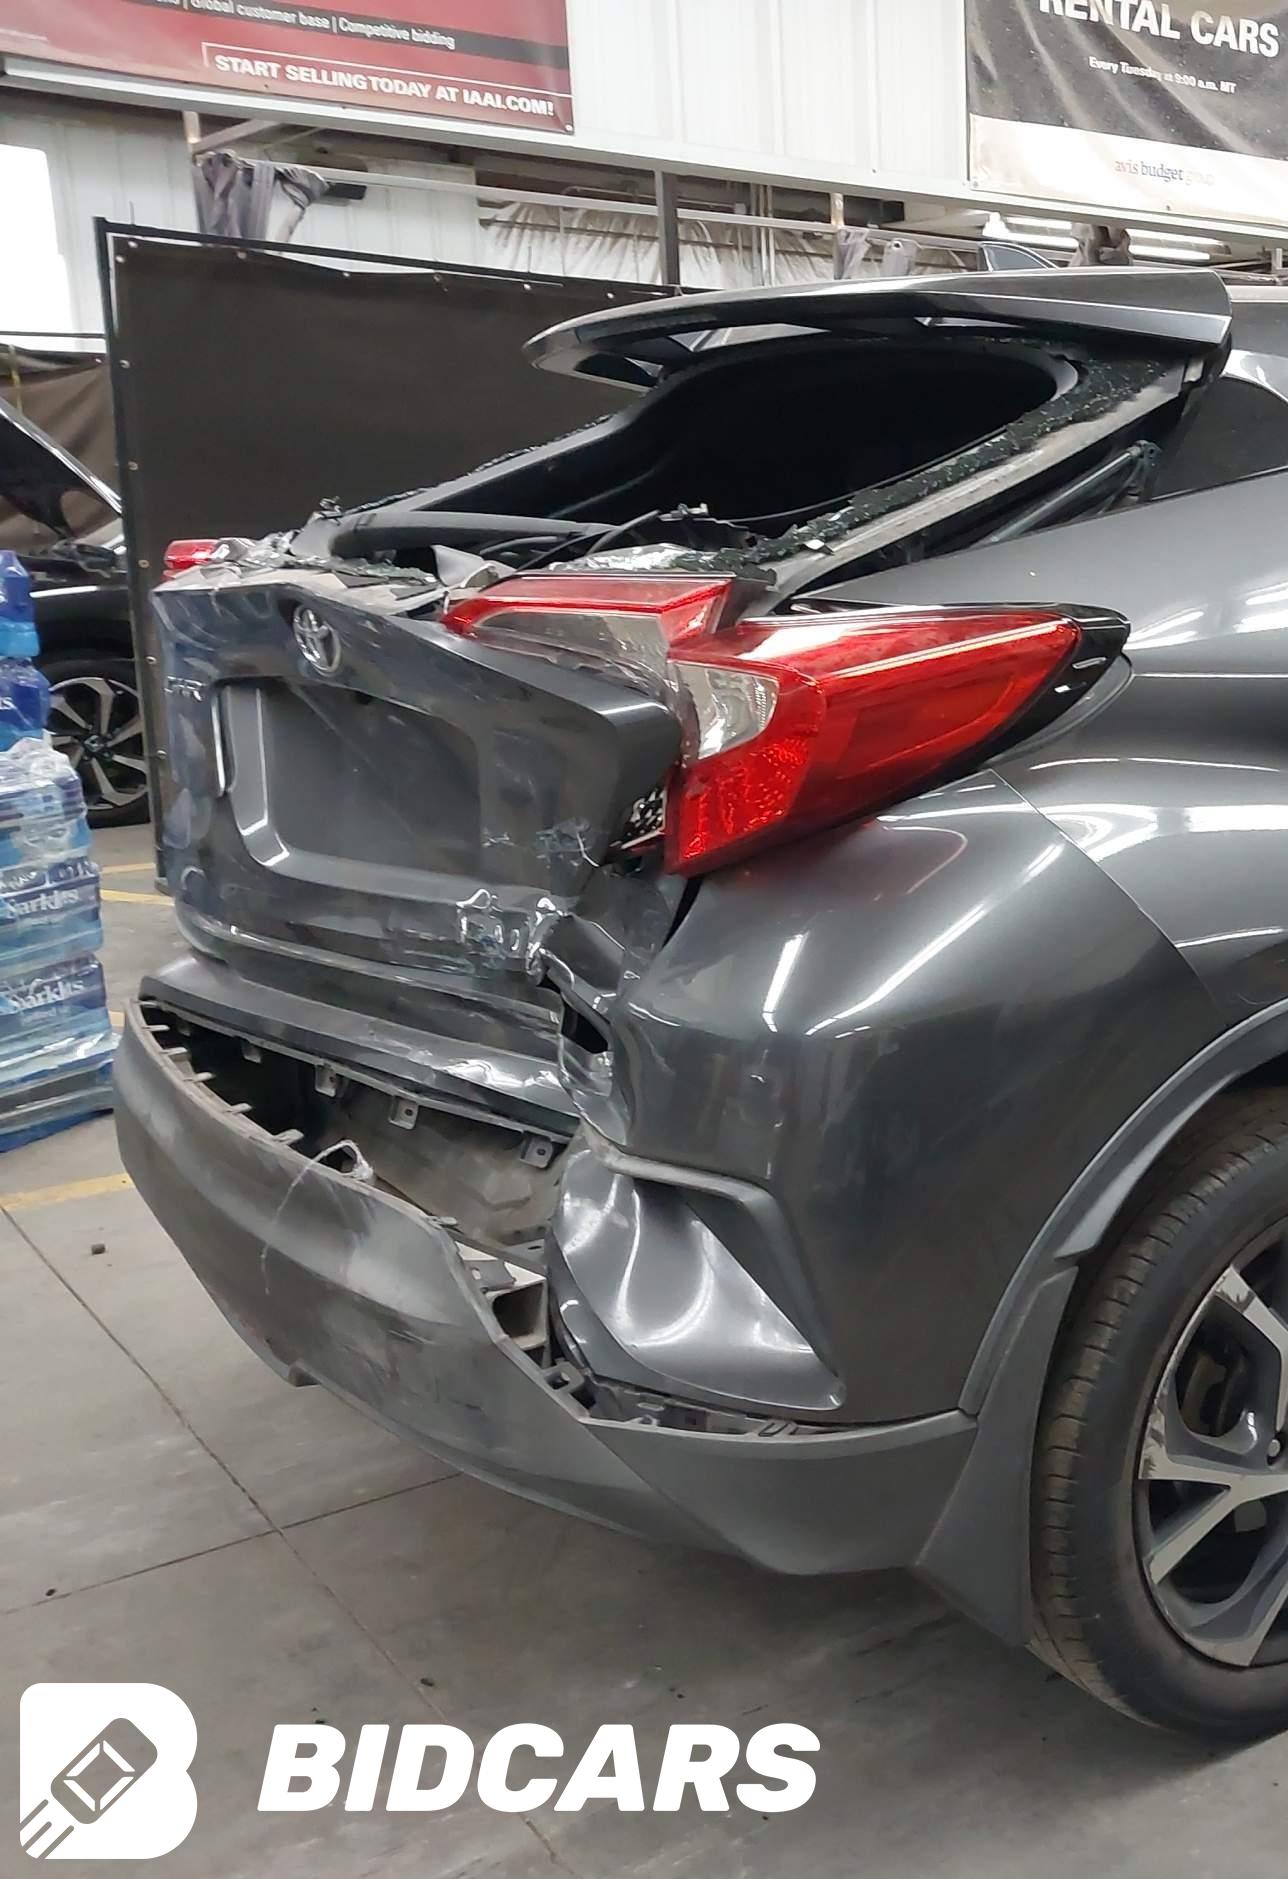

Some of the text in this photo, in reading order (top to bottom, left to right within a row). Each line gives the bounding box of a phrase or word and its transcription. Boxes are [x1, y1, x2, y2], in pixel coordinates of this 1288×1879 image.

[236, 5, 297, 24] customer
[298, 12, 331, 29] base
[338, 17, 410, 41] Competitive
[411, 28, 456, 50] bidding
[1191, 10, 1280, 58] CARS
[214, 55, 554, 116] START SELLING TODAY AT IAAI.COM!
[1088, 56, 1119, 74] Every
[1119, 61, 1162, 81] Tuesday
[1174, 73, 1197, 88] 9:00
[1114, 159, 1139, 175] avis
[1140, 161, 1184, 183] budget
